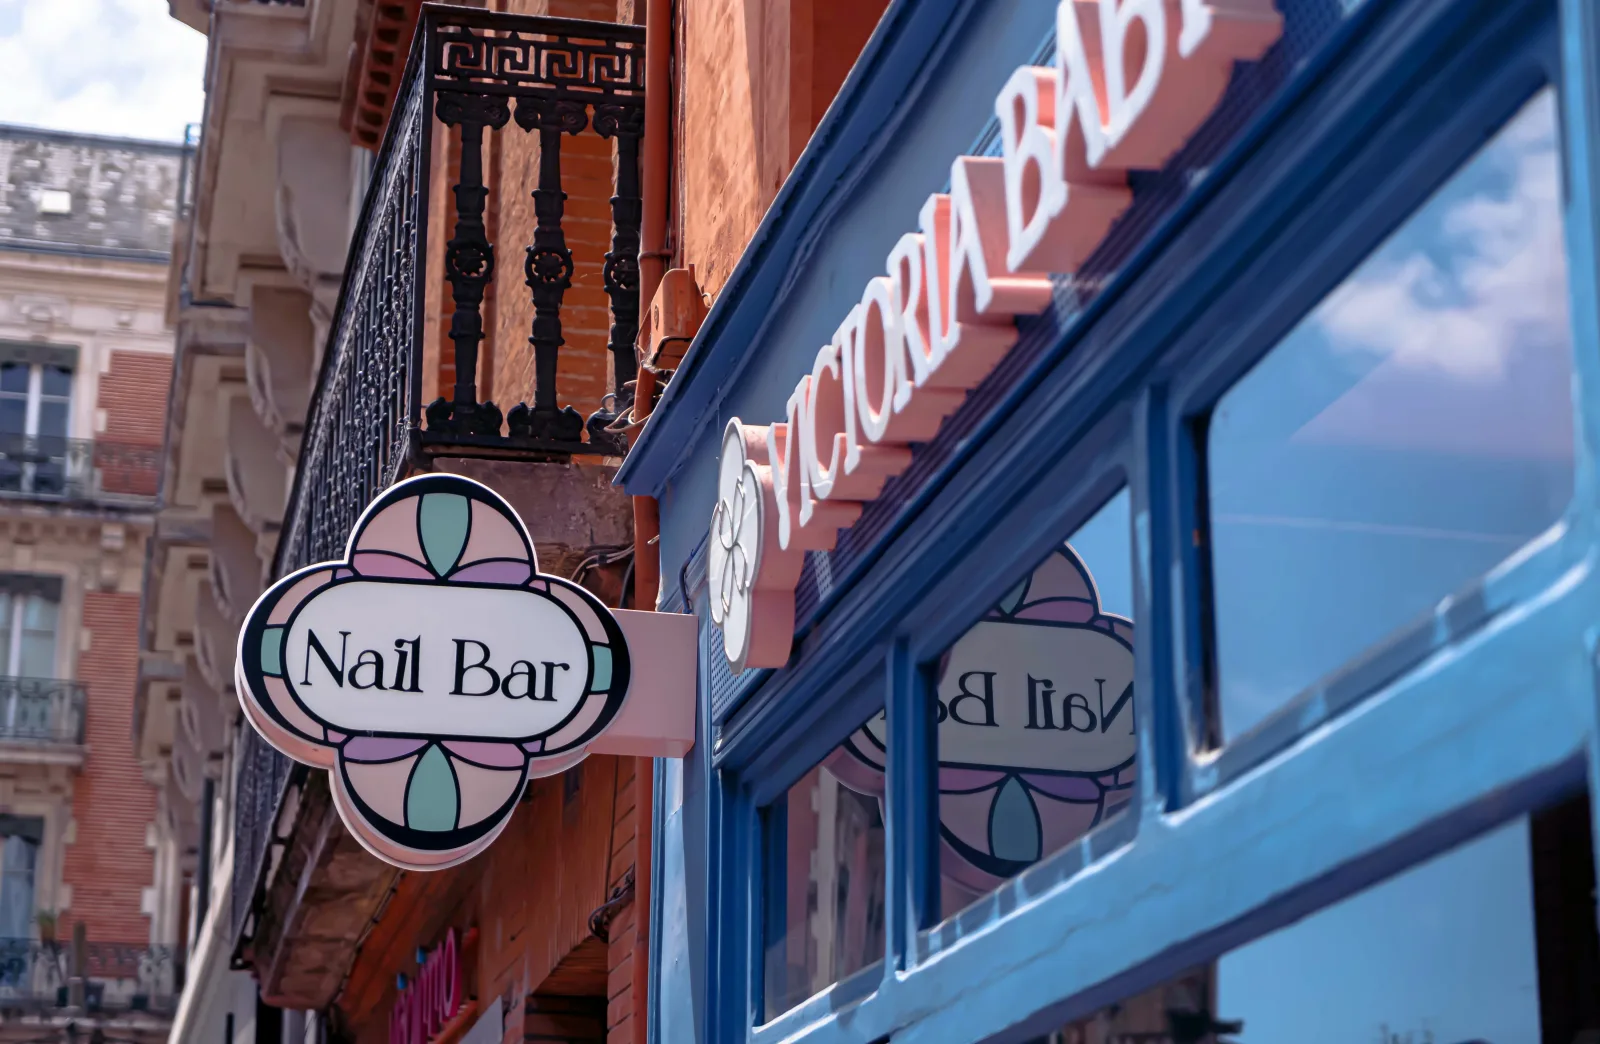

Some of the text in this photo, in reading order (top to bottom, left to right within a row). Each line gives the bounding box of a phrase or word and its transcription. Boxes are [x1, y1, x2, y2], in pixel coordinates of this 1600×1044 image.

[771, 156, 993, 551] VICTORIA
[299, 628, 571, 702] Nail Bar
